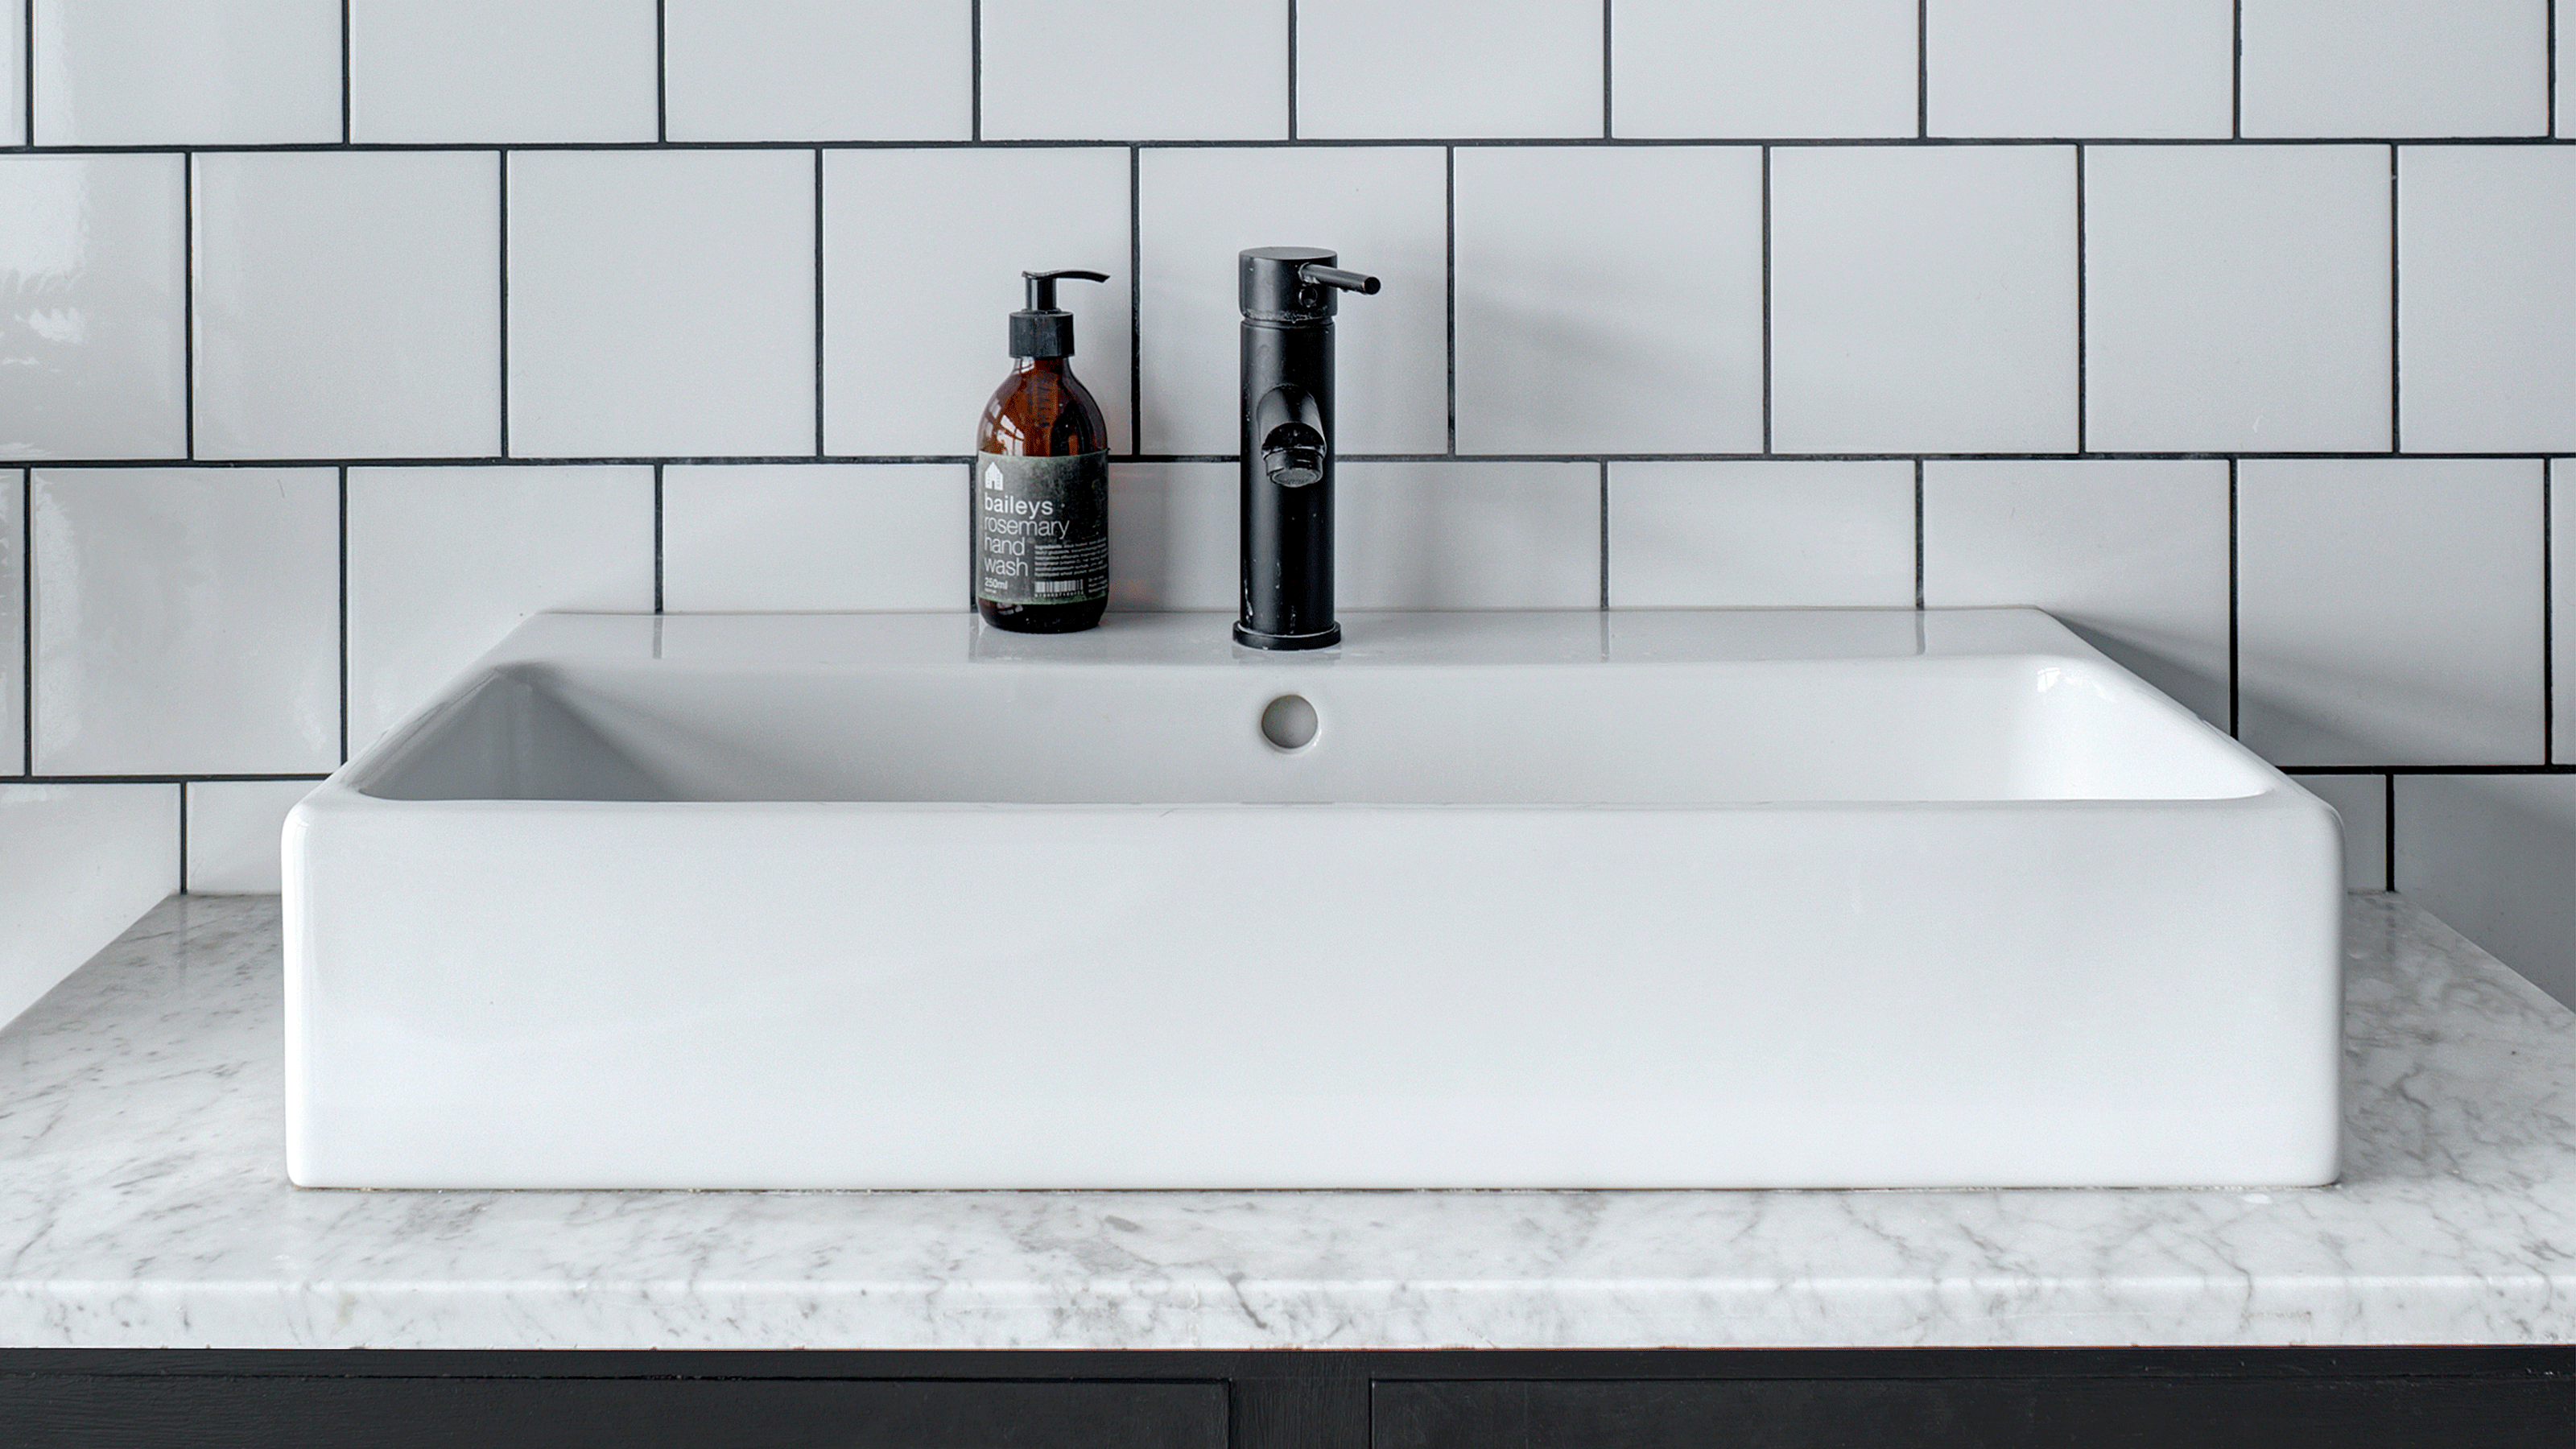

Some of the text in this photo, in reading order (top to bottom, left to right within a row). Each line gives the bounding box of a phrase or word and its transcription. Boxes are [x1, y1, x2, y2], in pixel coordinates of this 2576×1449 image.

[985, 492, 1054, 520] baileys
[985, 517, 1070, 539] rosemary
[985, 532, 1026, 556] hand
[984, 557, 1029, 577] wash
